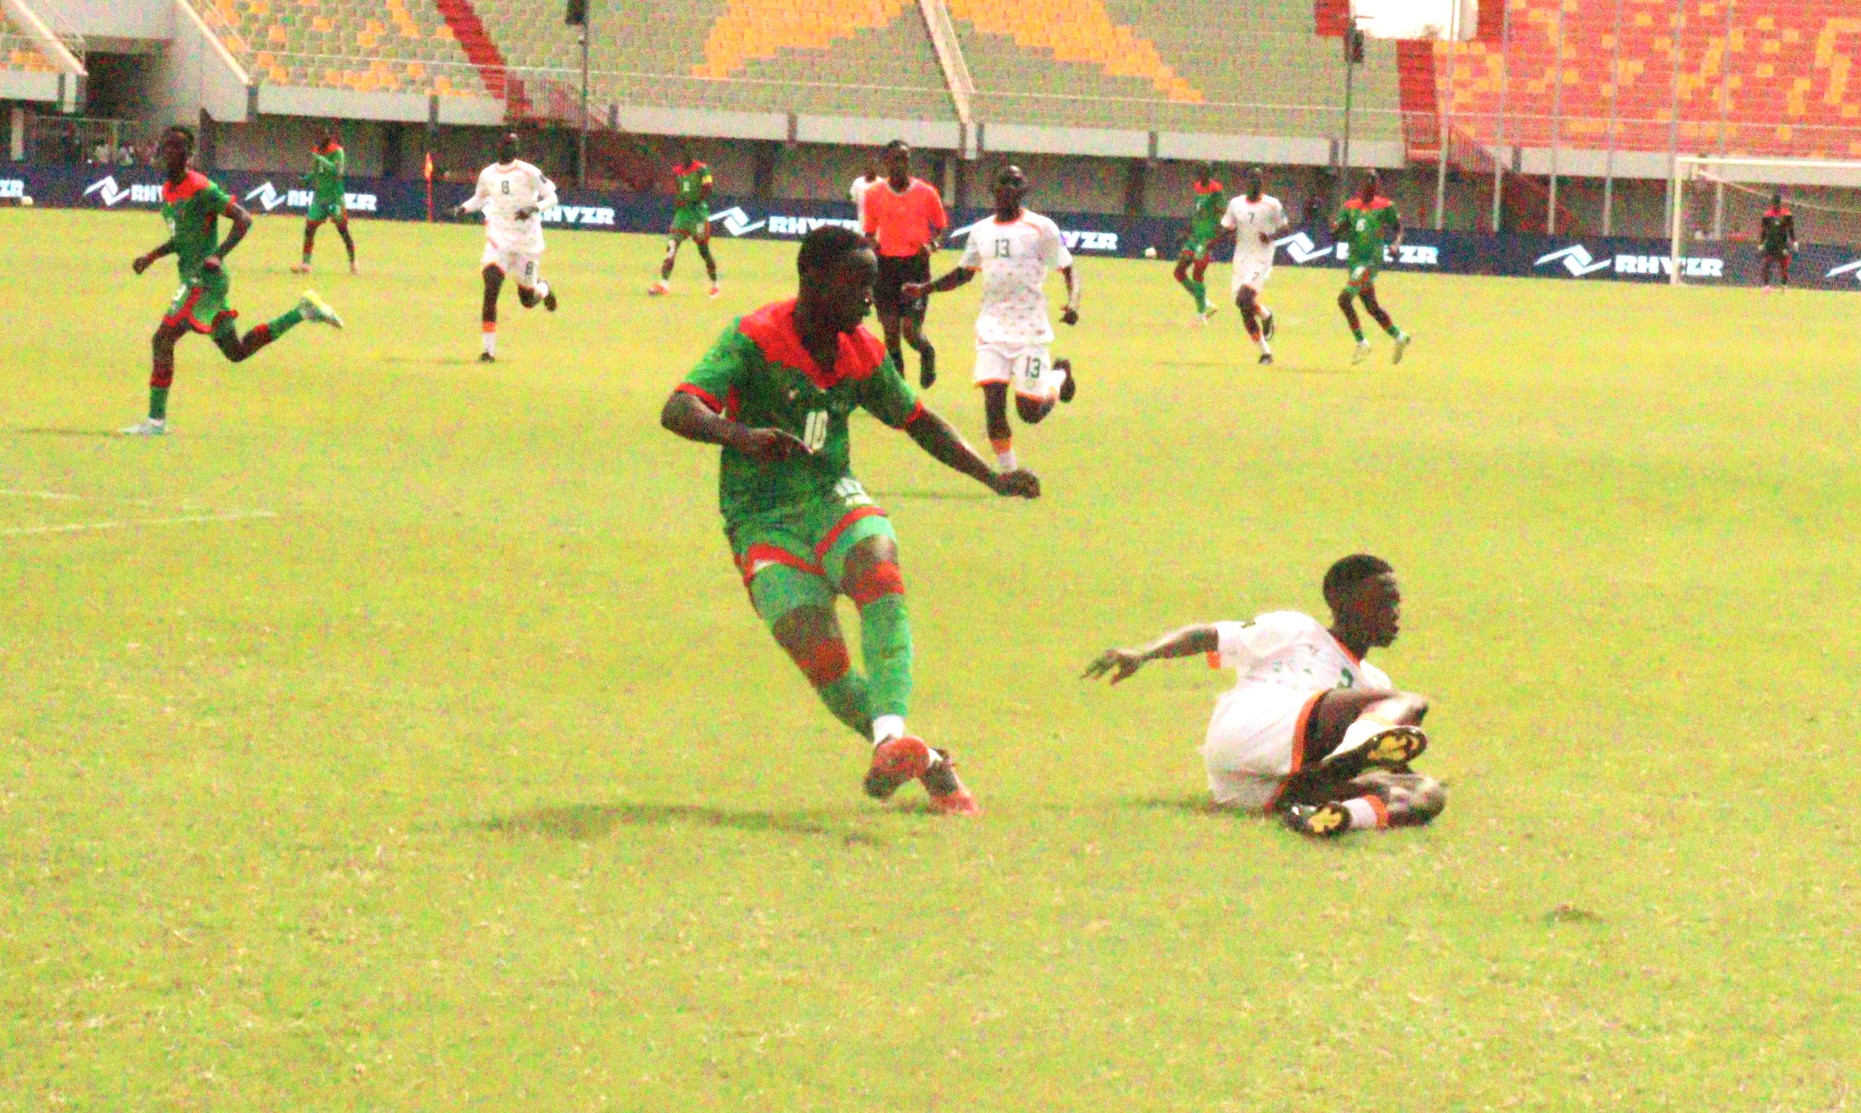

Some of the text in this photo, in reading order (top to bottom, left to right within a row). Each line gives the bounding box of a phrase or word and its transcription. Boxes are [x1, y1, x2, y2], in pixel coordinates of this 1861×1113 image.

[501, 180, 511, 195] 8
[994, 238, 1011, 259] 13
[1025, 356, 1042, 379] 13
[804, 410, 829, 450] 10
